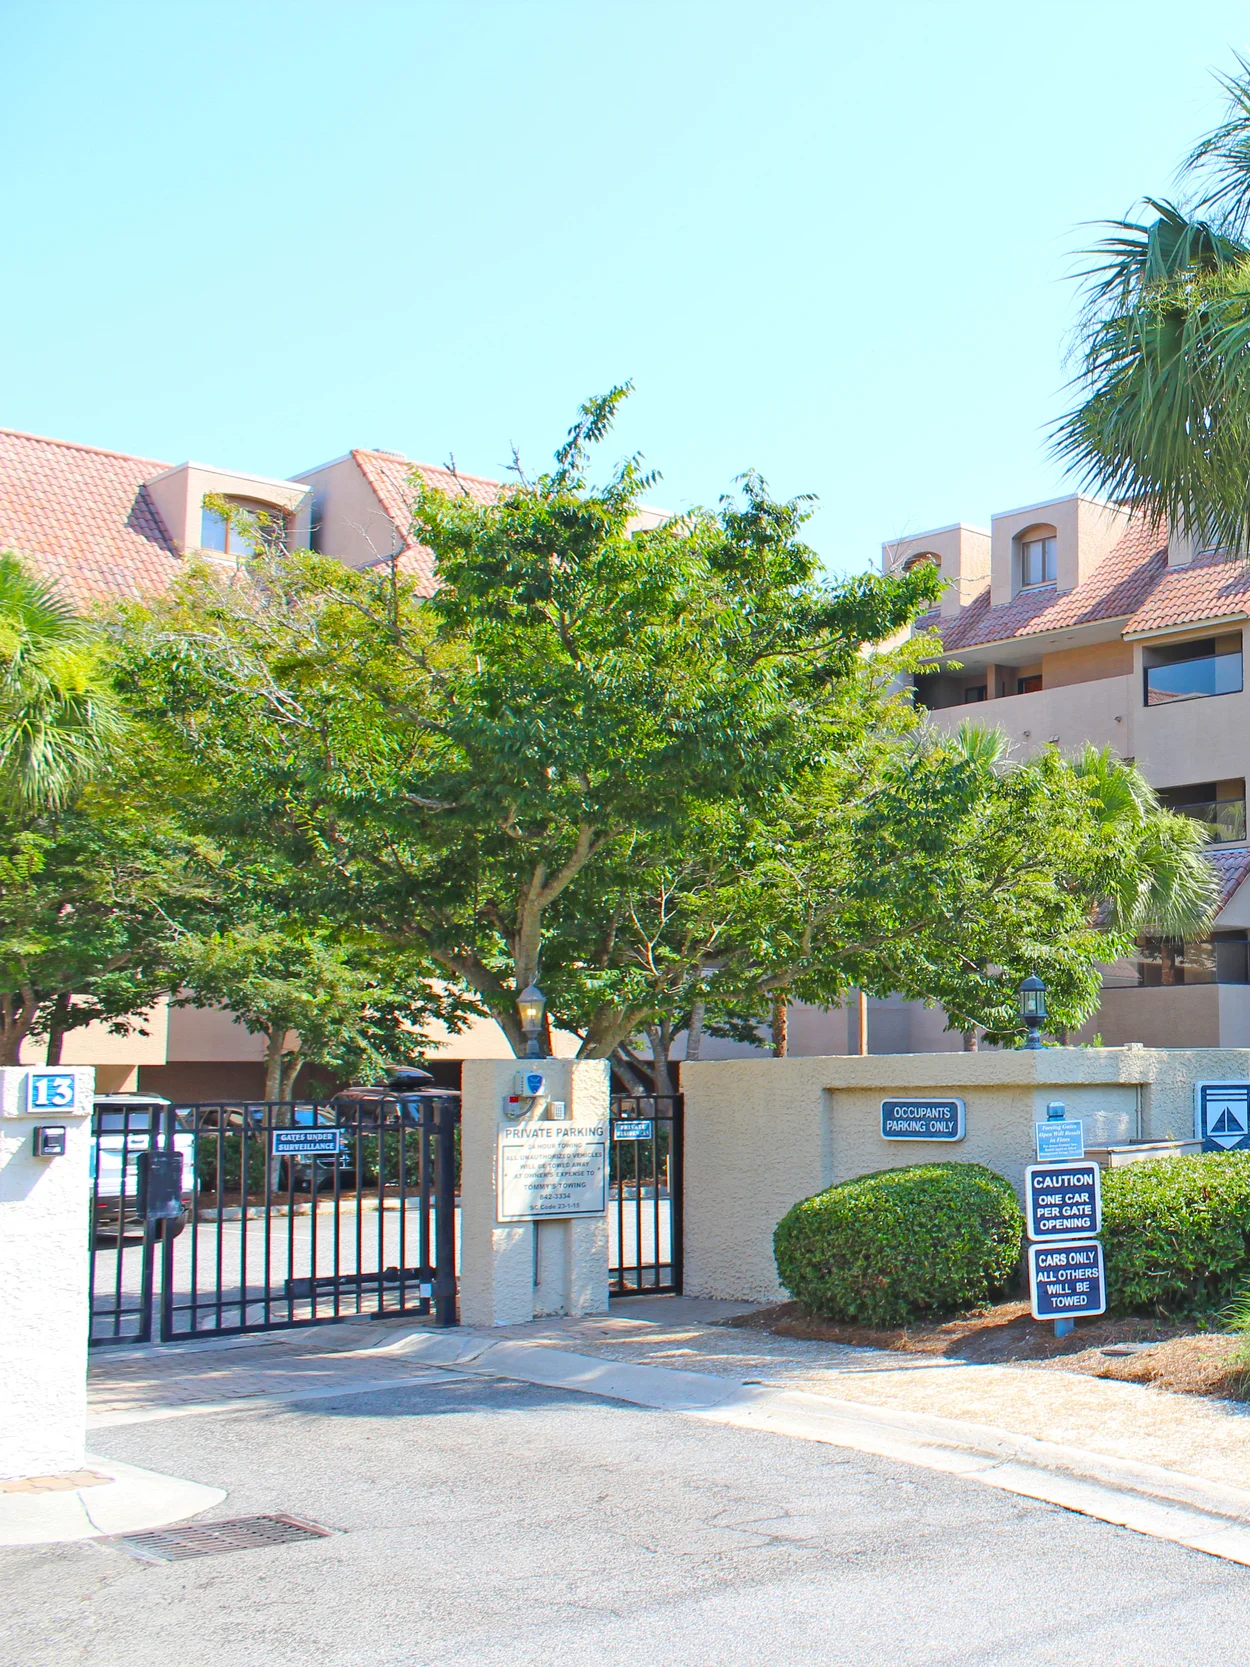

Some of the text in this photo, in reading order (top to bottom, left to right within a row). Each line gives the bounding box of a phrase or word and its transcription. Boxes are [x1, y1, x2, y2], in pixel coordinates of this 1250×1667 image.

[35, 1077, 73, 1106] 13
[893, 1107, 951, 1118] OCCUPANTS
[886, 1120, 954, 1132] PARKING ONLY
[280, 1133, 305, 1141] GATES
[504, 1127, 604, 1139] PRIVATE PARKING
[278, 1142, 334, 1151] SURVEILLANCE
[524, 1182, 586, 1191] TOMMY'S TOWING
[1033, 1173, 1093, 1188] CAUTION
[1038, 1193, 1090, 1205] ONE CAR
[1036, 1205, 1092, 1218] PER GATE
[1040, 1217, 1091, 1230] OPENING
[1038, 1251, 1095, 1267] CARS ONLY
[1036, 1267, 1099, 1282] ALL OTHERS
[1046, 1281, 1090, 1295] WILL BE
[1050, 1295, 1088, 1308] TOWED
